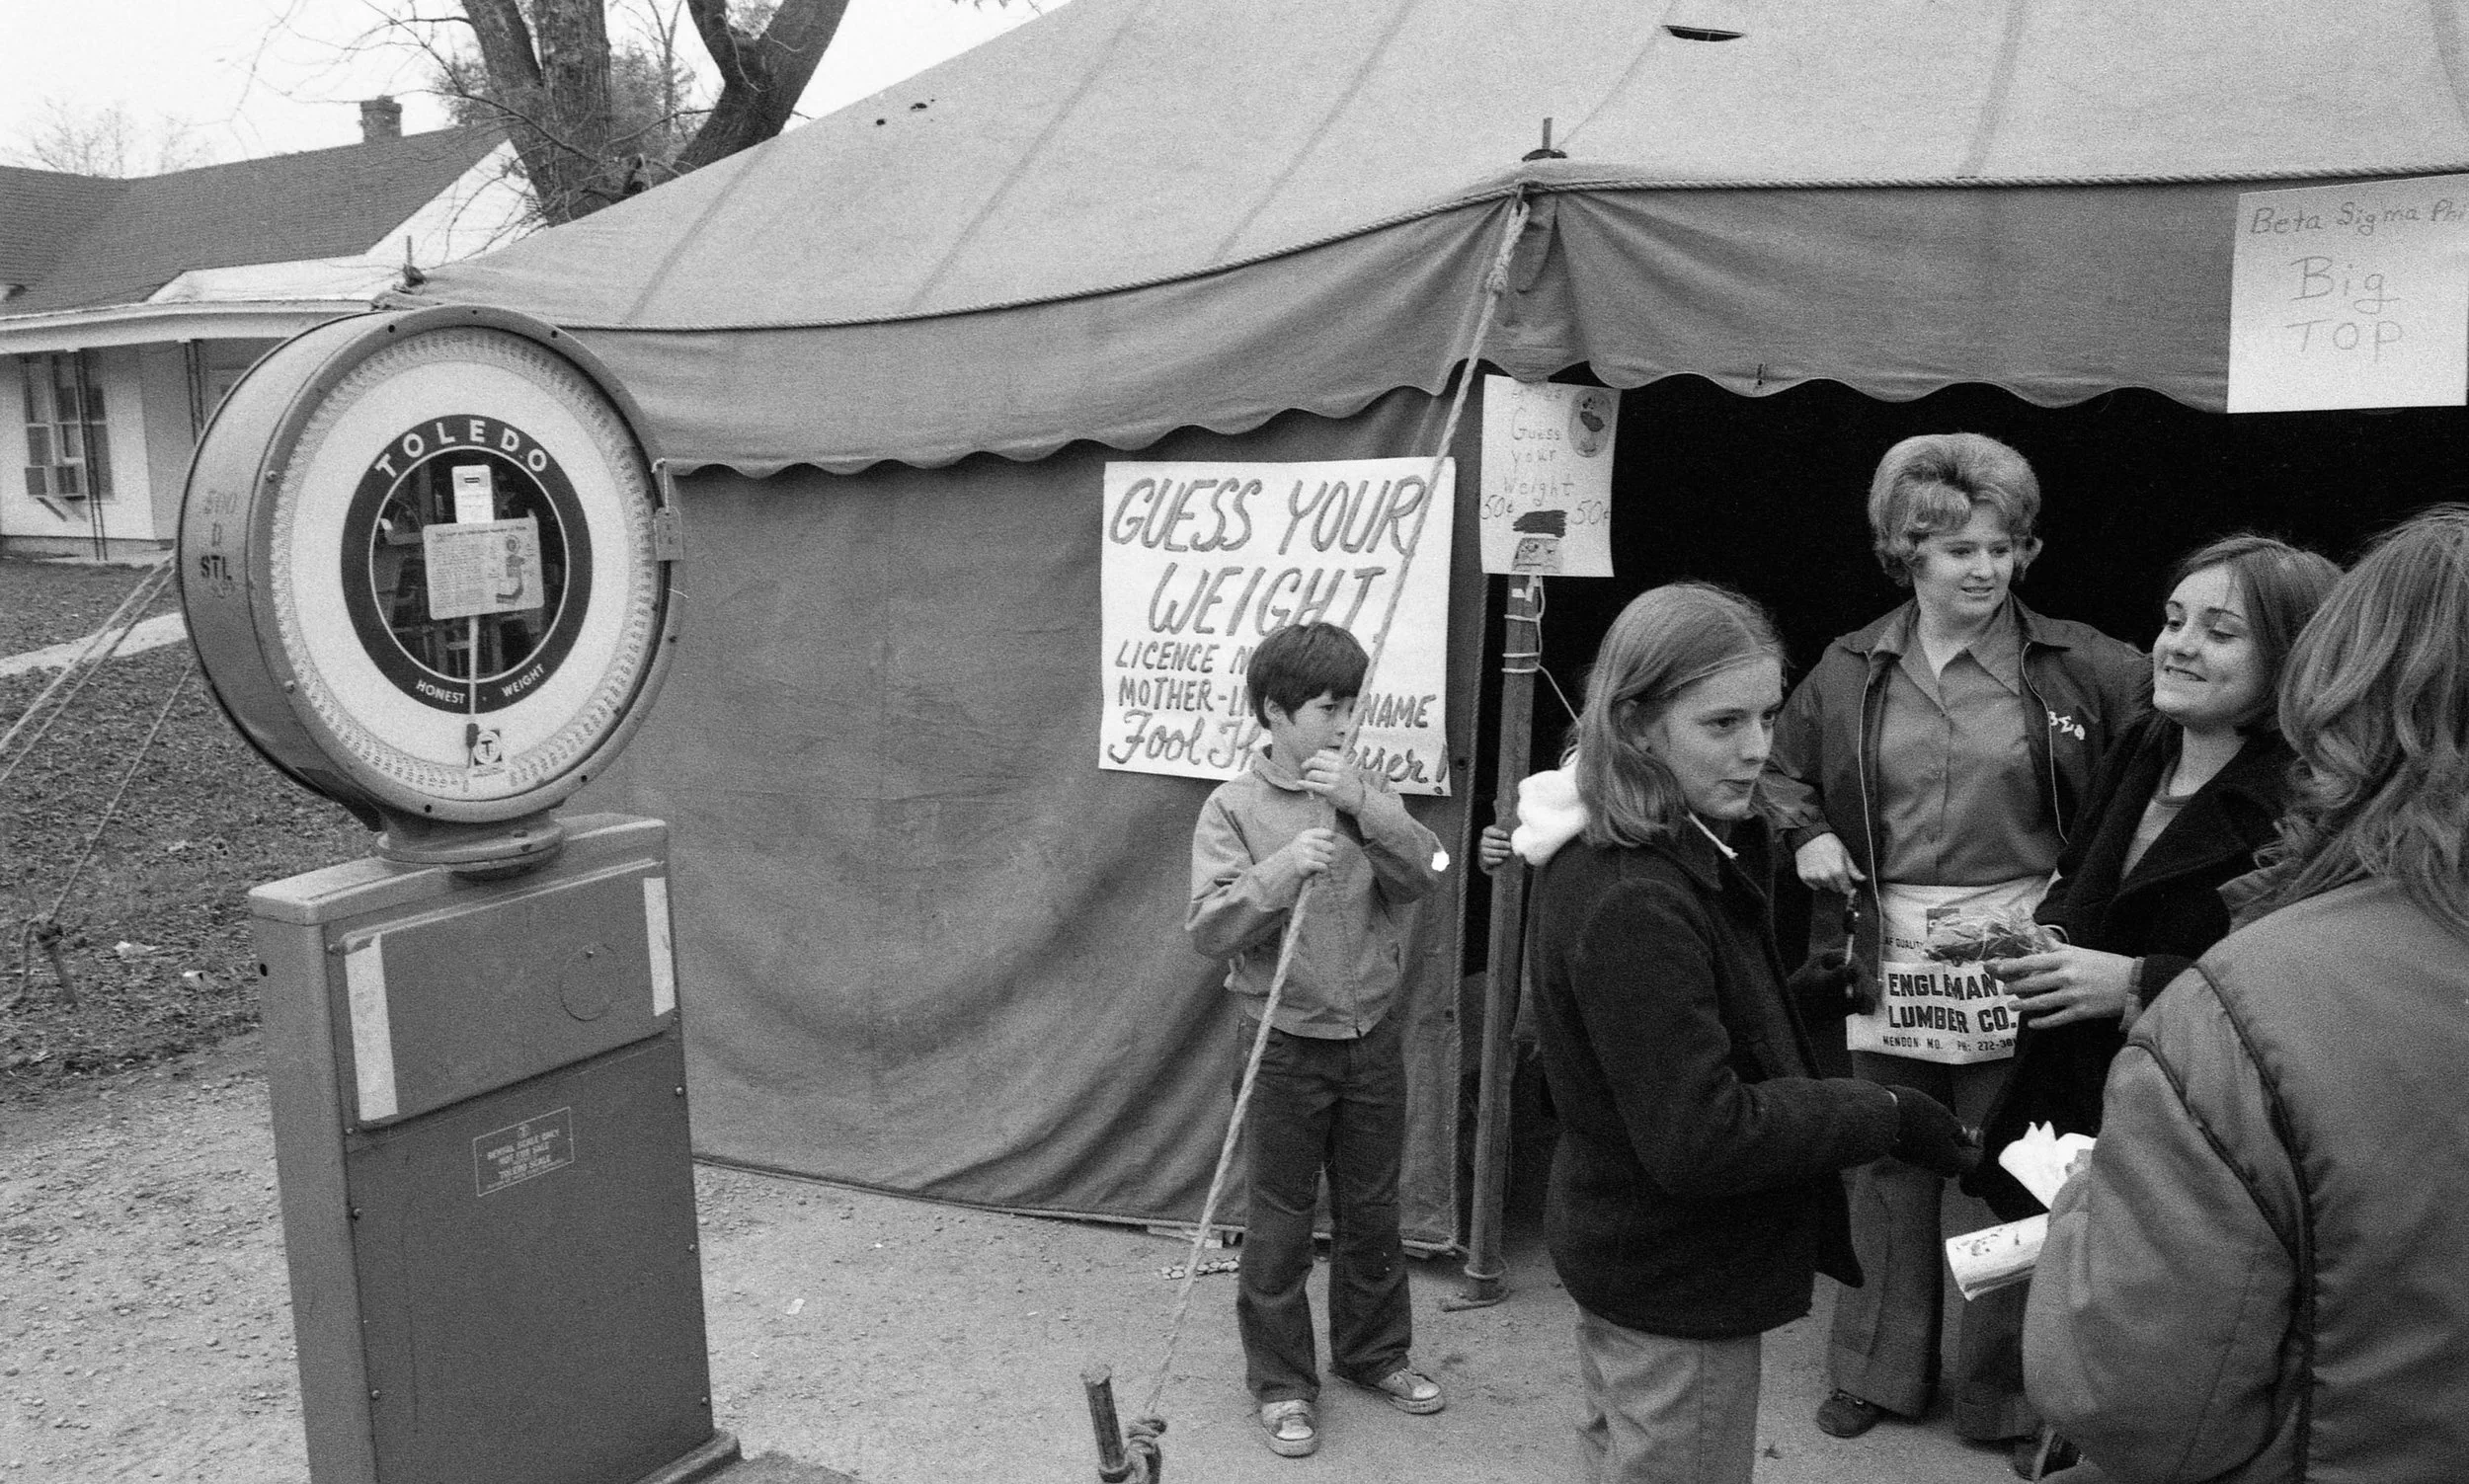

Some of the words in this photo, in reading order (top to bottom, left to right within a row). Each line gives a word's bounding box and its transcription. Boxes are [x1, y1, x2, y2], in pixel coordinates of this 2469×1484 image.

[2251, 206, 2323, 234] Beta
[2336, 200, 2420, 236] Sigma
[2289, 255, 2401, 315] Big
[375, 419, 548, 479] TOLEDO
[1109, 478, 1263, 553] GUESS
[1278, 474, 1428, 556] YOUR
[1148, 562, 1387, 637] WEIGHT
[1115, 639, 1221, 673] LICENCE
[415, 677, 466, 704] HONEST
[501, 663, 546, 697] WEIGHT
[1359, 693, 1437, 728] NAME
[1107, 709, 1206, 765] Fool
[1887, 1005, 1970, 1034] LUMBER
[1977, 1005, 2018, 1033] CO.
